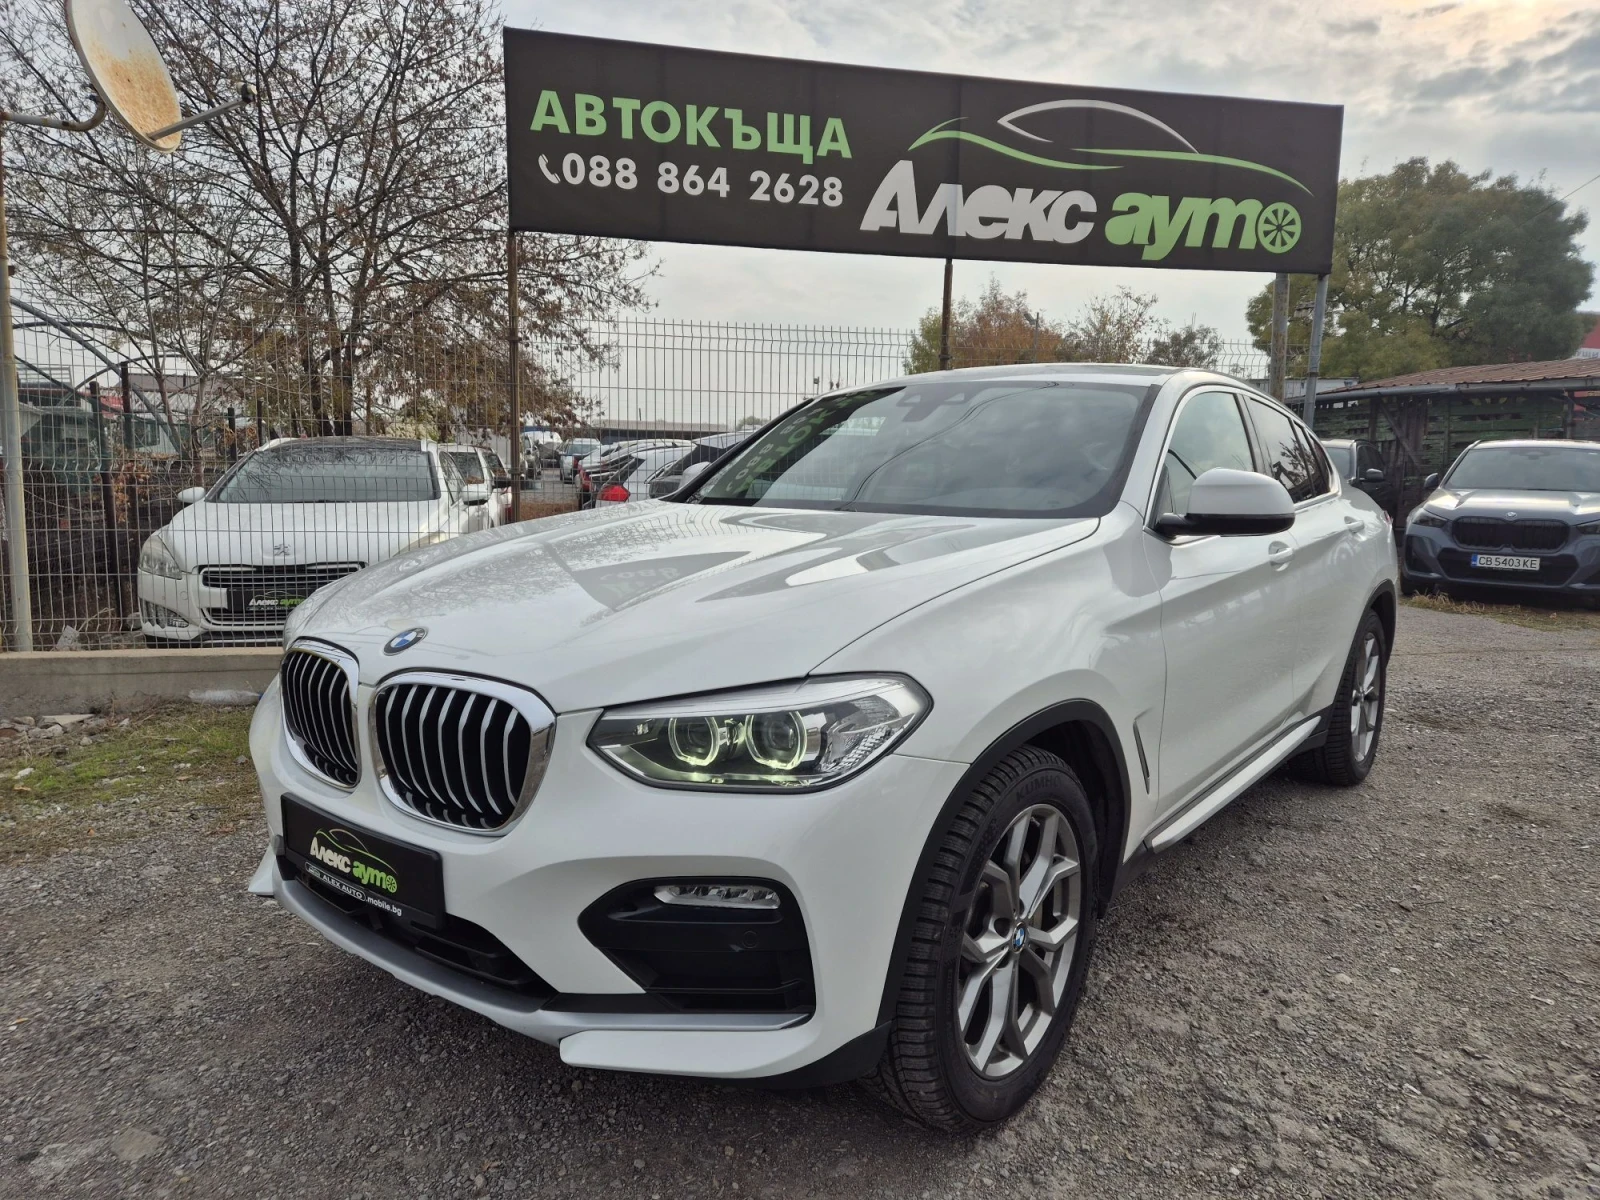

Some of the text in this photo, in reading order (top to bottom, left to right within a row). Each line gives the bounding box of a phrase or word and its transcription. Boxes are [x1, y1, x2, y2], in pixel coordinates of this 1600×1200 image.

[530, 90, 852, 164] АВТОКЪЩА
[562, 153, 843, 207] 088 864 2628
[1016, 775, 1062, 802] KUMHO
[322, 874, 341, 889] ALEX
[342, 884, 363, 899] AUTO
